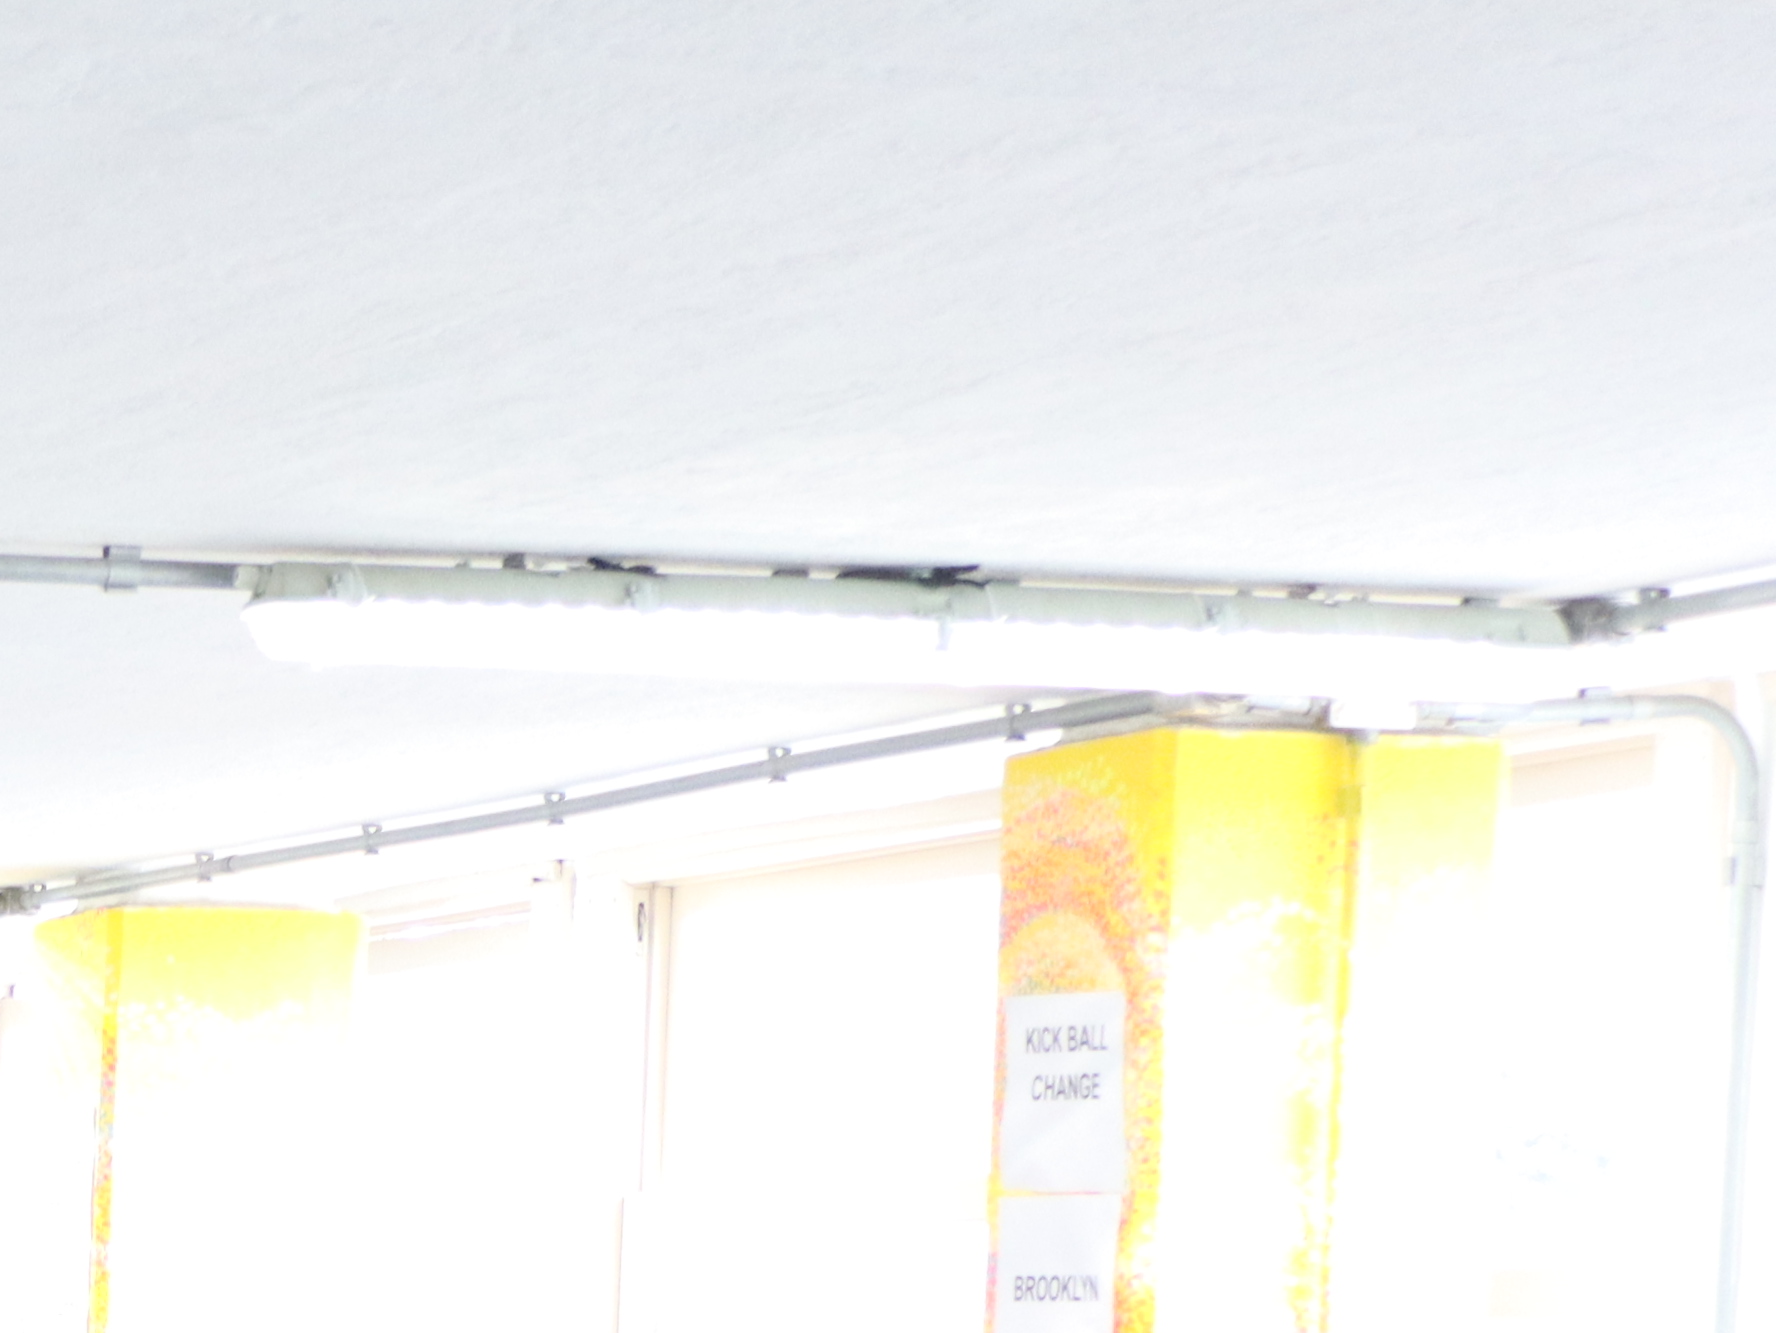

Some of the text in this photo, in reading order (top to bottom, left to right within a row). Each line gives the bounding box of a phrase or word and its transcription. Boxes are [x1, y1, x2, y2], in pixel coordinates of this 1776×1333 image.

[1025, 1024, 1108, 1053] KICK BALL
[1031, 1073, 1100, 1101] CHANGE
[1013, 1275, 1098, 1301] BROOKLYN
